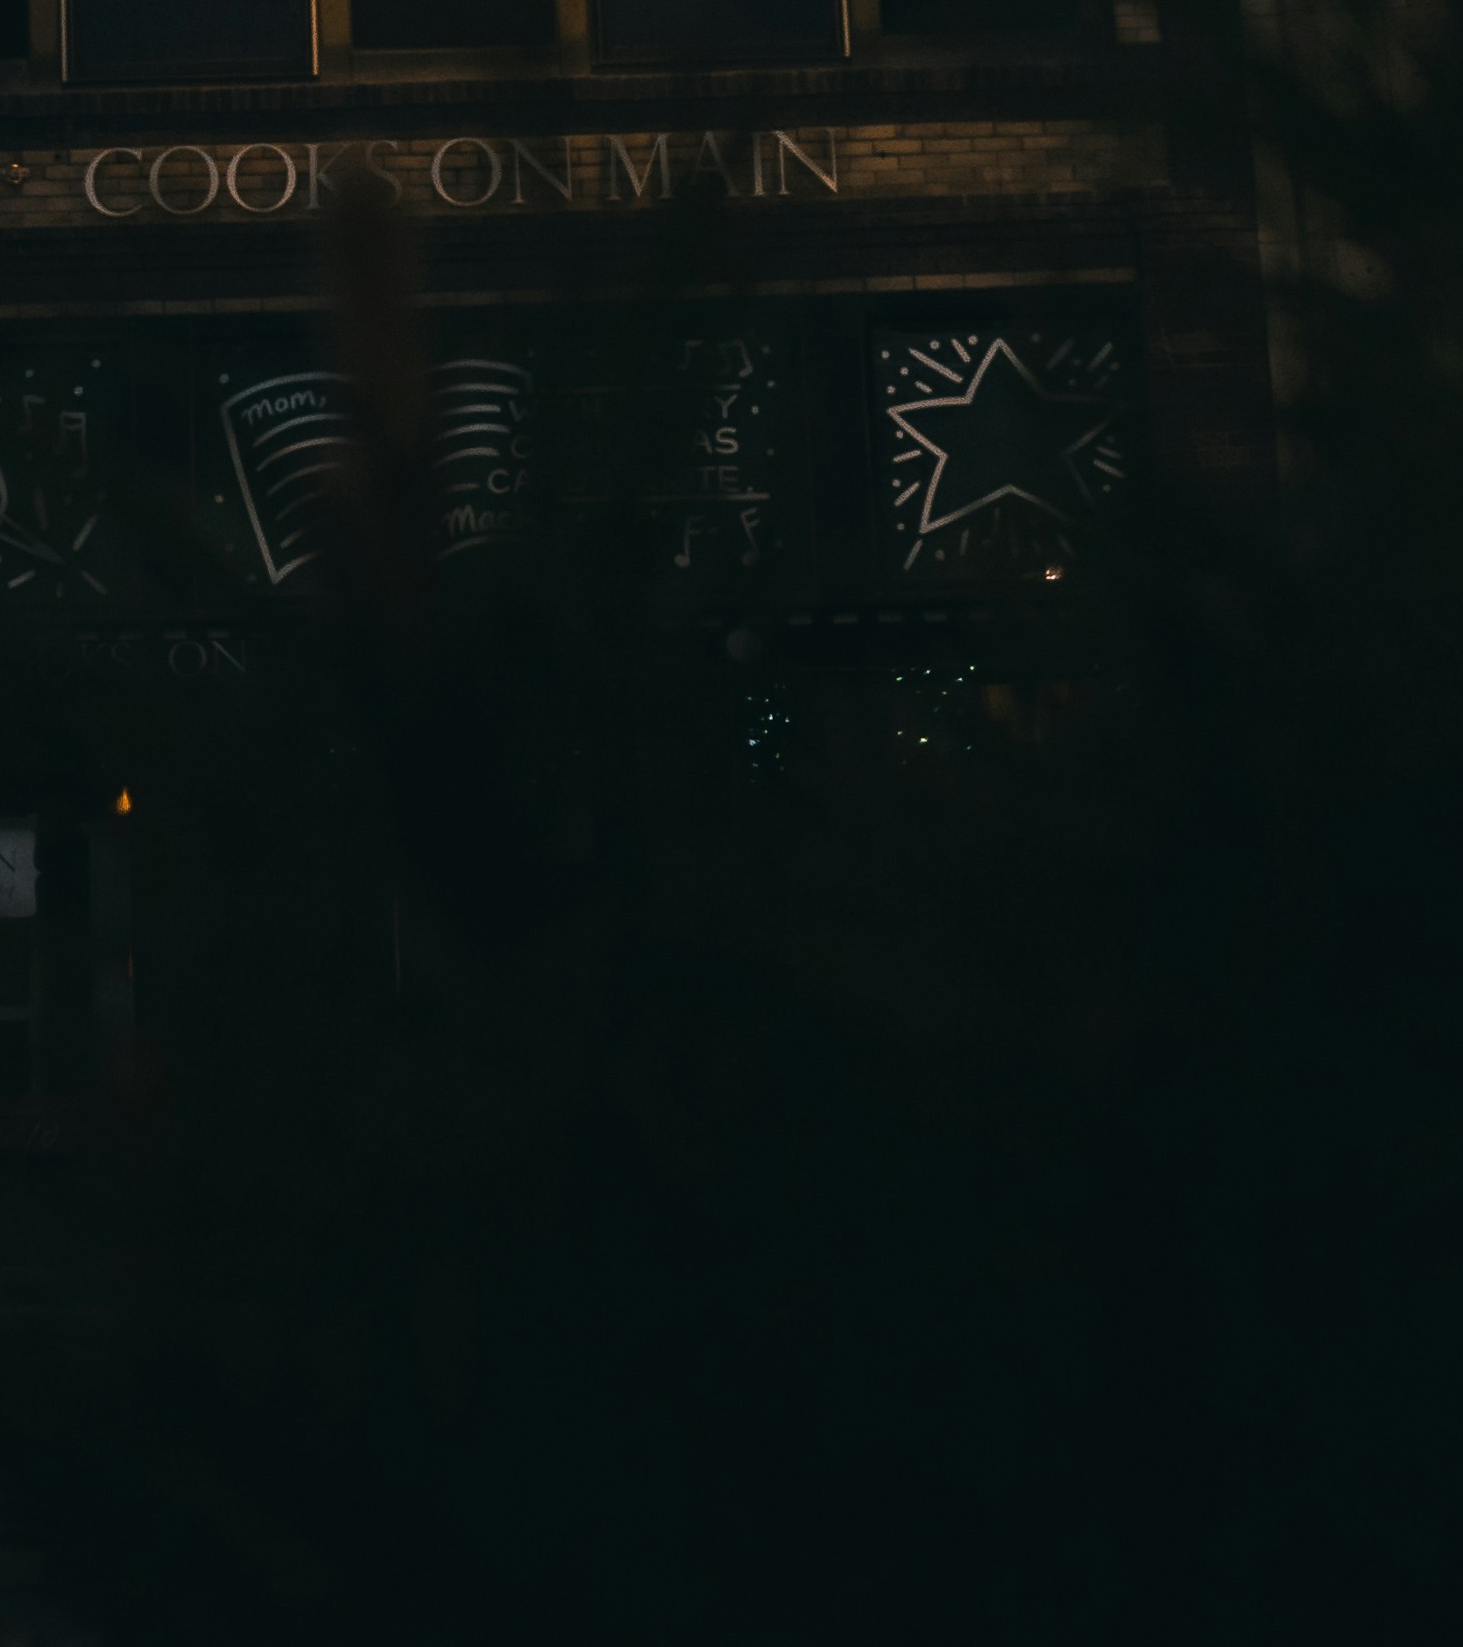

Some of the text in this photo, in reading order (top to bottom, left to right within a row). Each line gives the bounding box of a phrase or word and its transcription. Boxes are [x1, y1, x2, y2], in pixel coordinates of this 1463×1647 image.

[83, 128, 841, 218] COOKS ON MAIN
[167, 638, 248, 678] ON
